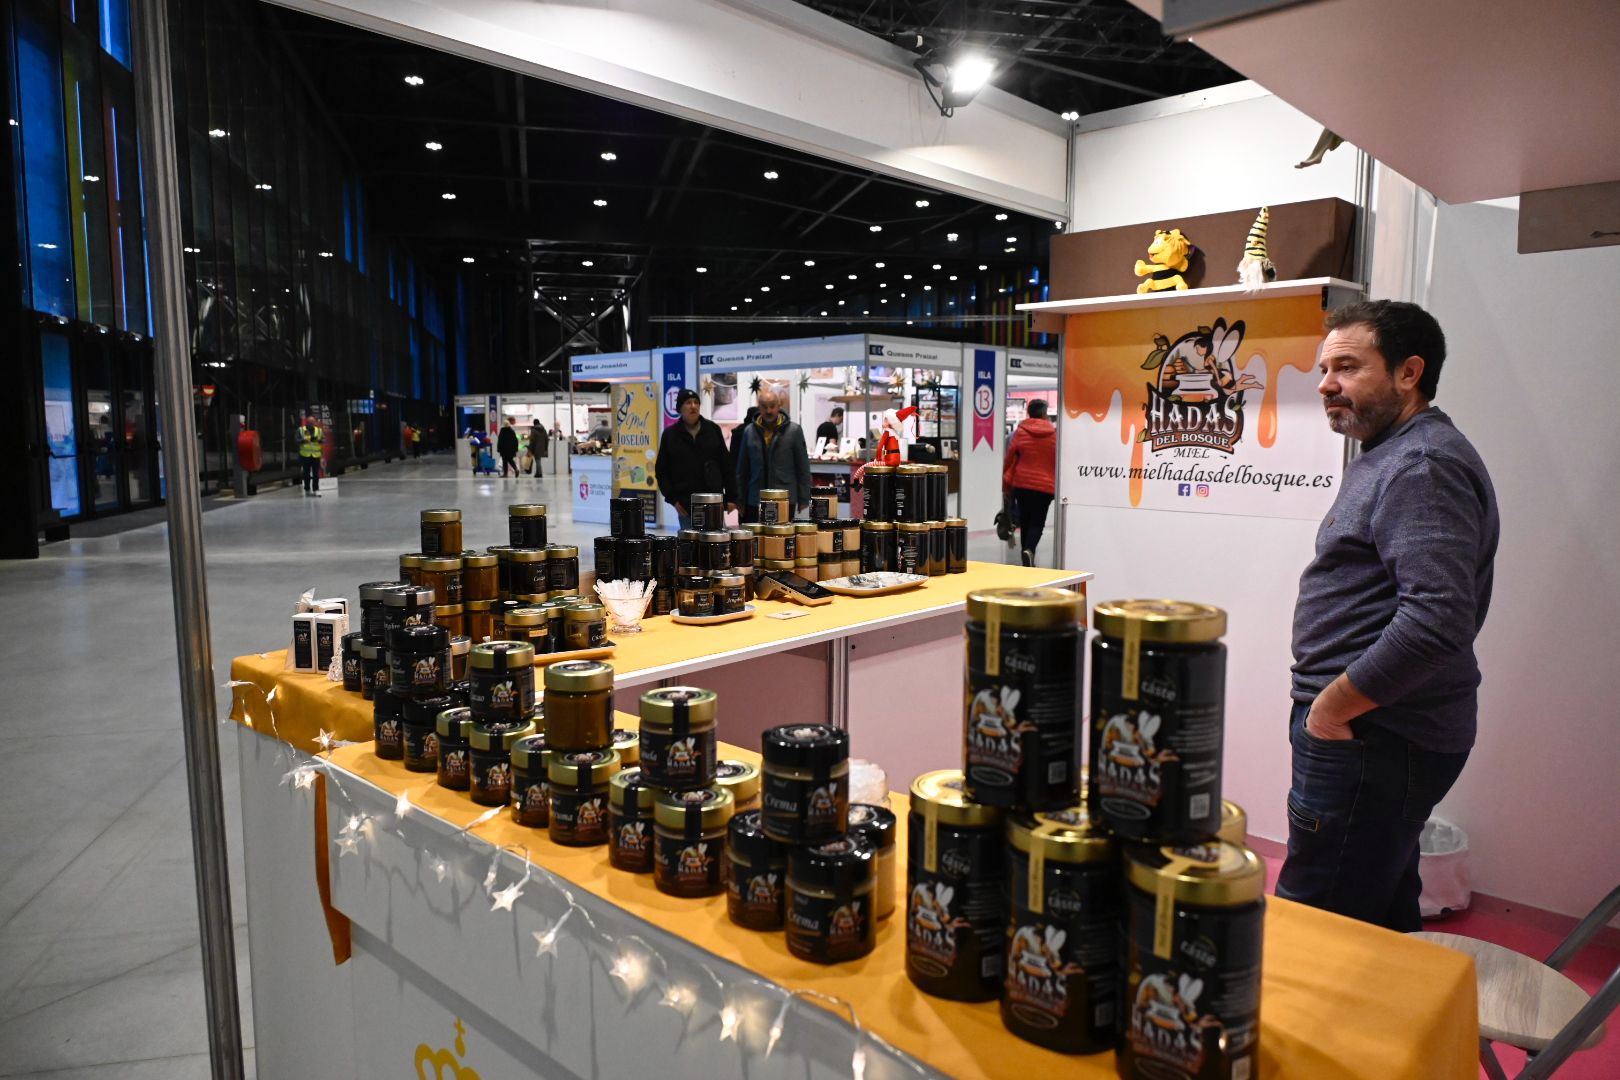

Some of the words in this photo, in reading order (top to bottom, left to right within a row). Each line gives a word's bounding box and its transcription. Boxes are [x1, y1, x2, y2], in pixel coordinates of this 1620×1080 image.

[747, 353, 773, 361] Praizal
[887, 350, 913, 359] Quesos
[915, 352, 938, 360] Praizal
[667, 373, 681, 381] ISLA
[977, 371, 992, 379] ISLA
[978, 390, 990, 410] 13
[1151, 391, 1239, 437] HADAS
[1156, 435, 1178, 446] DEL
[1181, 433, 1230, 449] BOSQUE
[1172, 448, 1211, 460] MIEL
[1077, 462, 1334, 492] www.mielhadasdelbosque.es
[764, 793, 798, 812] Crema
